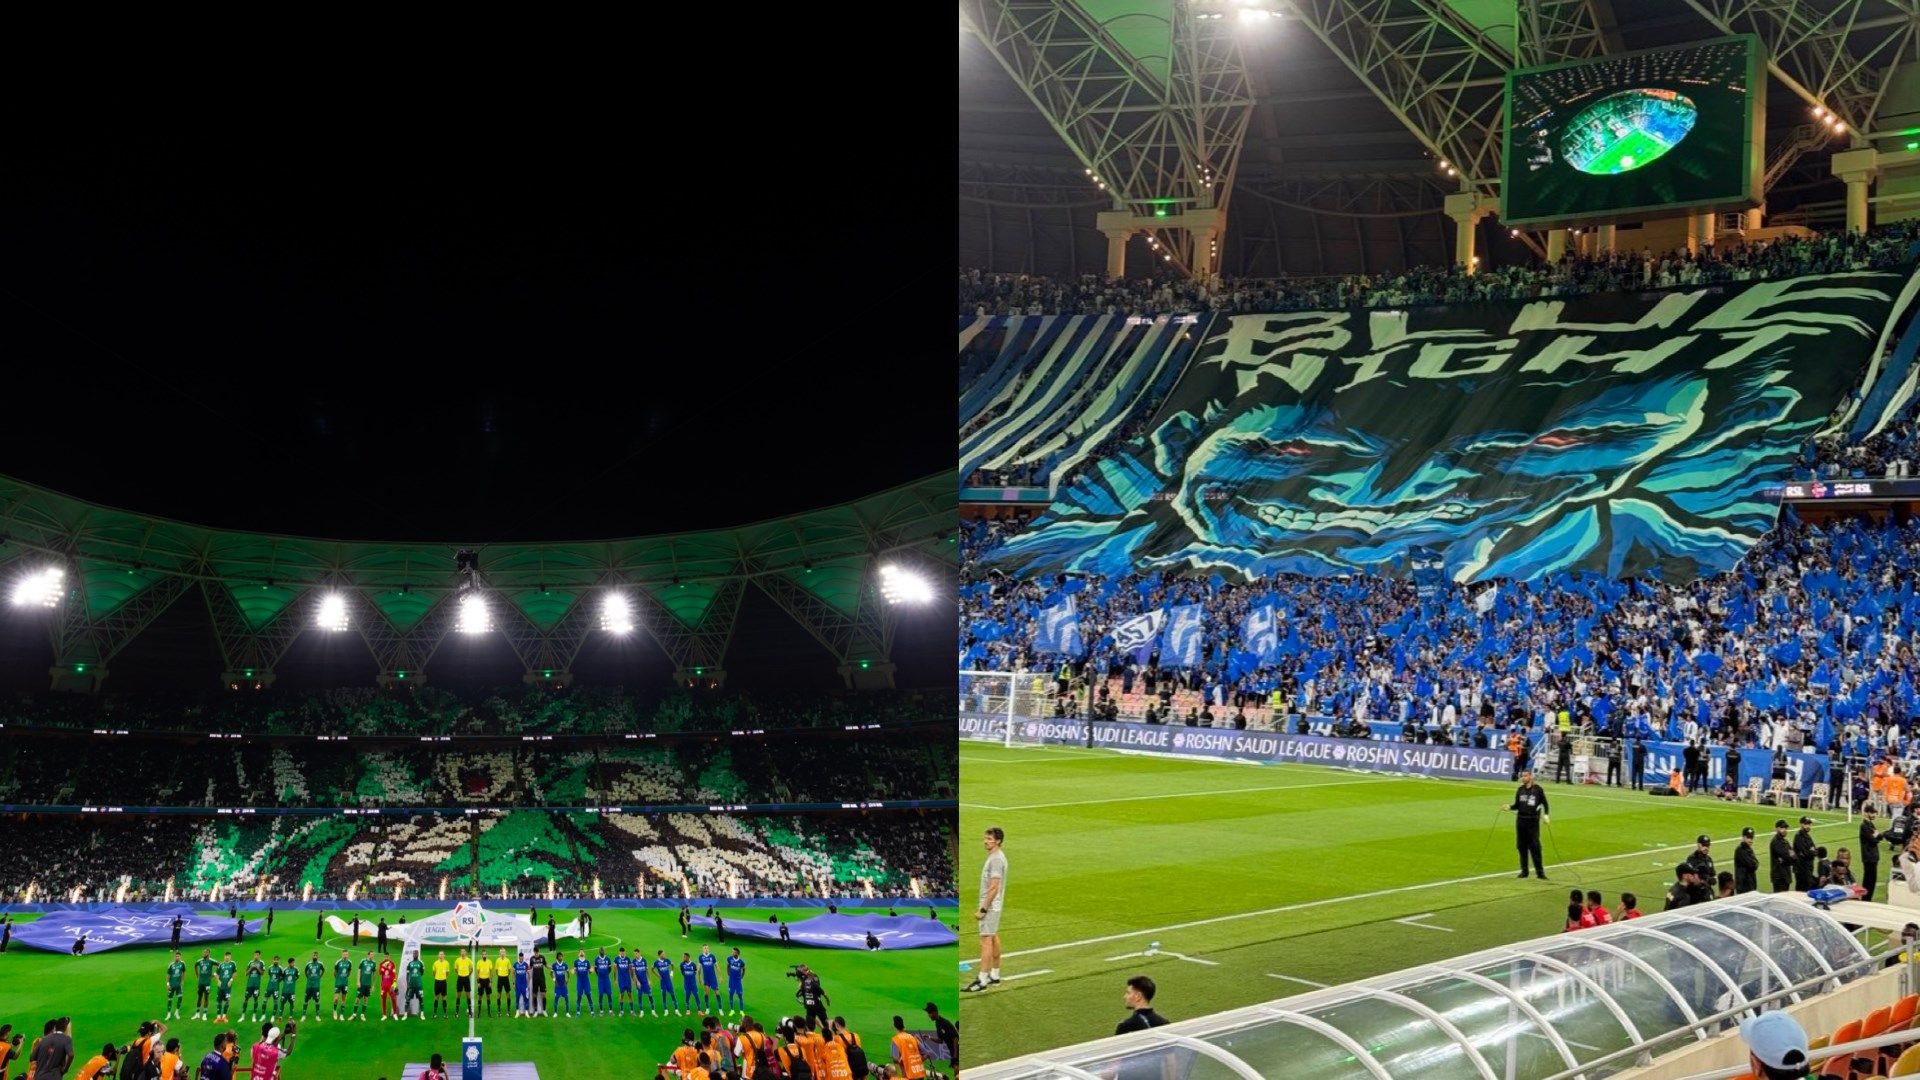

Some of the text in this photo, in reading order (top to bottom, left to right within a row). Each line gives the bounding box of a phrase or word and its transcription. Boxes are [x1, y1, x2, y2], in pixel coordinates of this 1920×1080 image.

[1786, 486, 1804, 497] RSL
[959, 718, 981, 732] UDI
[1038, 724, 1080, 740] ROSHN
[1122, 729, 1169, 747] LEAGUE
[1186, 734, 1331, 759] ROSHN SAUDI LEAGUE
[1347, 746, 1511, 774] ROSHN SAUDI LEAGUE
[462, 917, 475, 925] RSL
